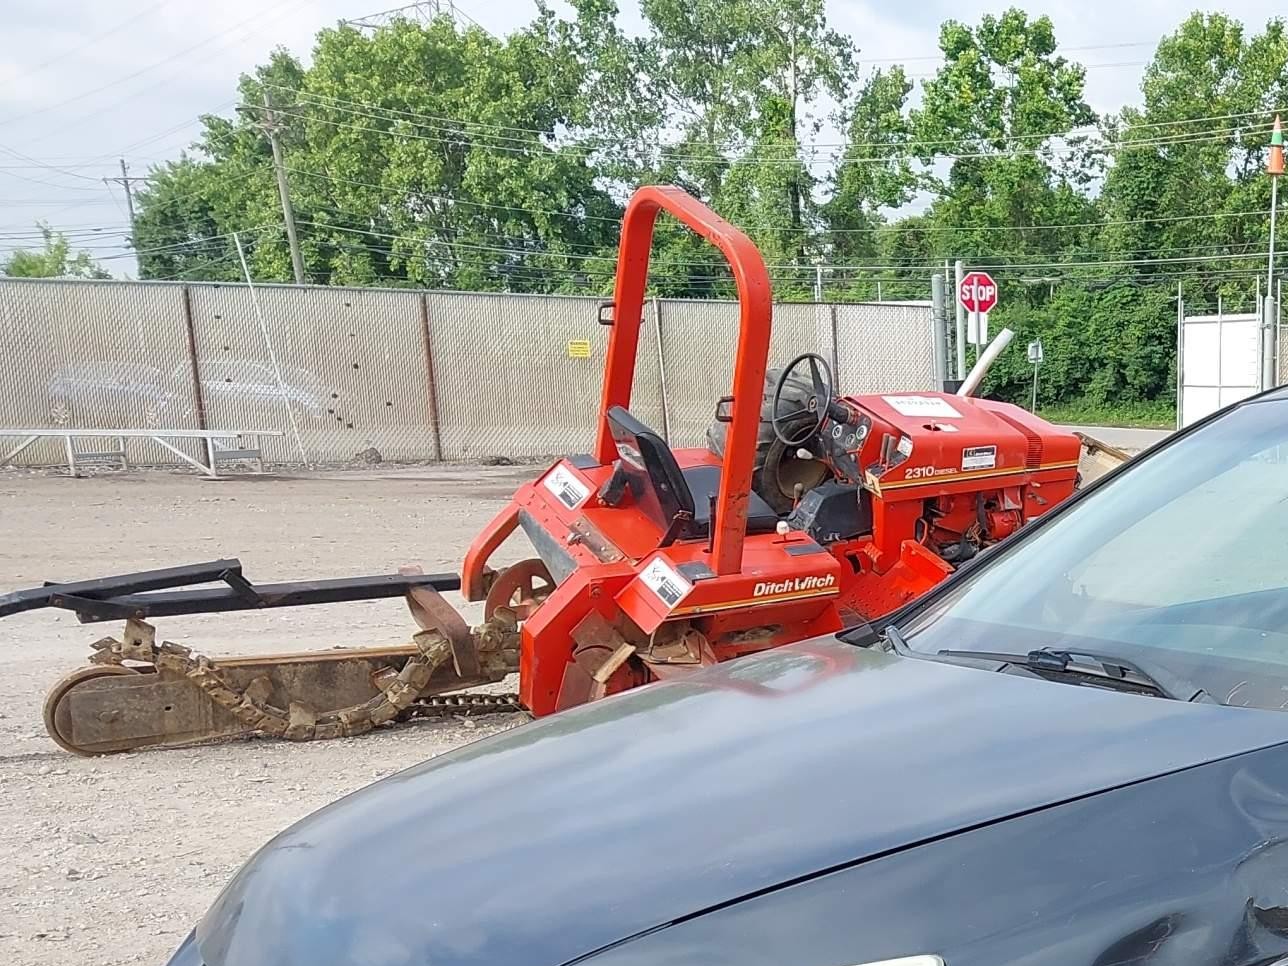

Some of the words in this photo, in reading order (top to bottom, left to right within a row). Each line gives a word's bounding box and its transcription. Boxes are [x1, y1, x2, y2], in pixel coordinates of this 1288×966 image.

[961, 285, 995, 301] STOP
[904, 466, 935, 479] 2310
[935, 467, 958, 475] DIESEL
[753, 579, 793, 597] Ditch
[794, 573, 835, 591] Witch
